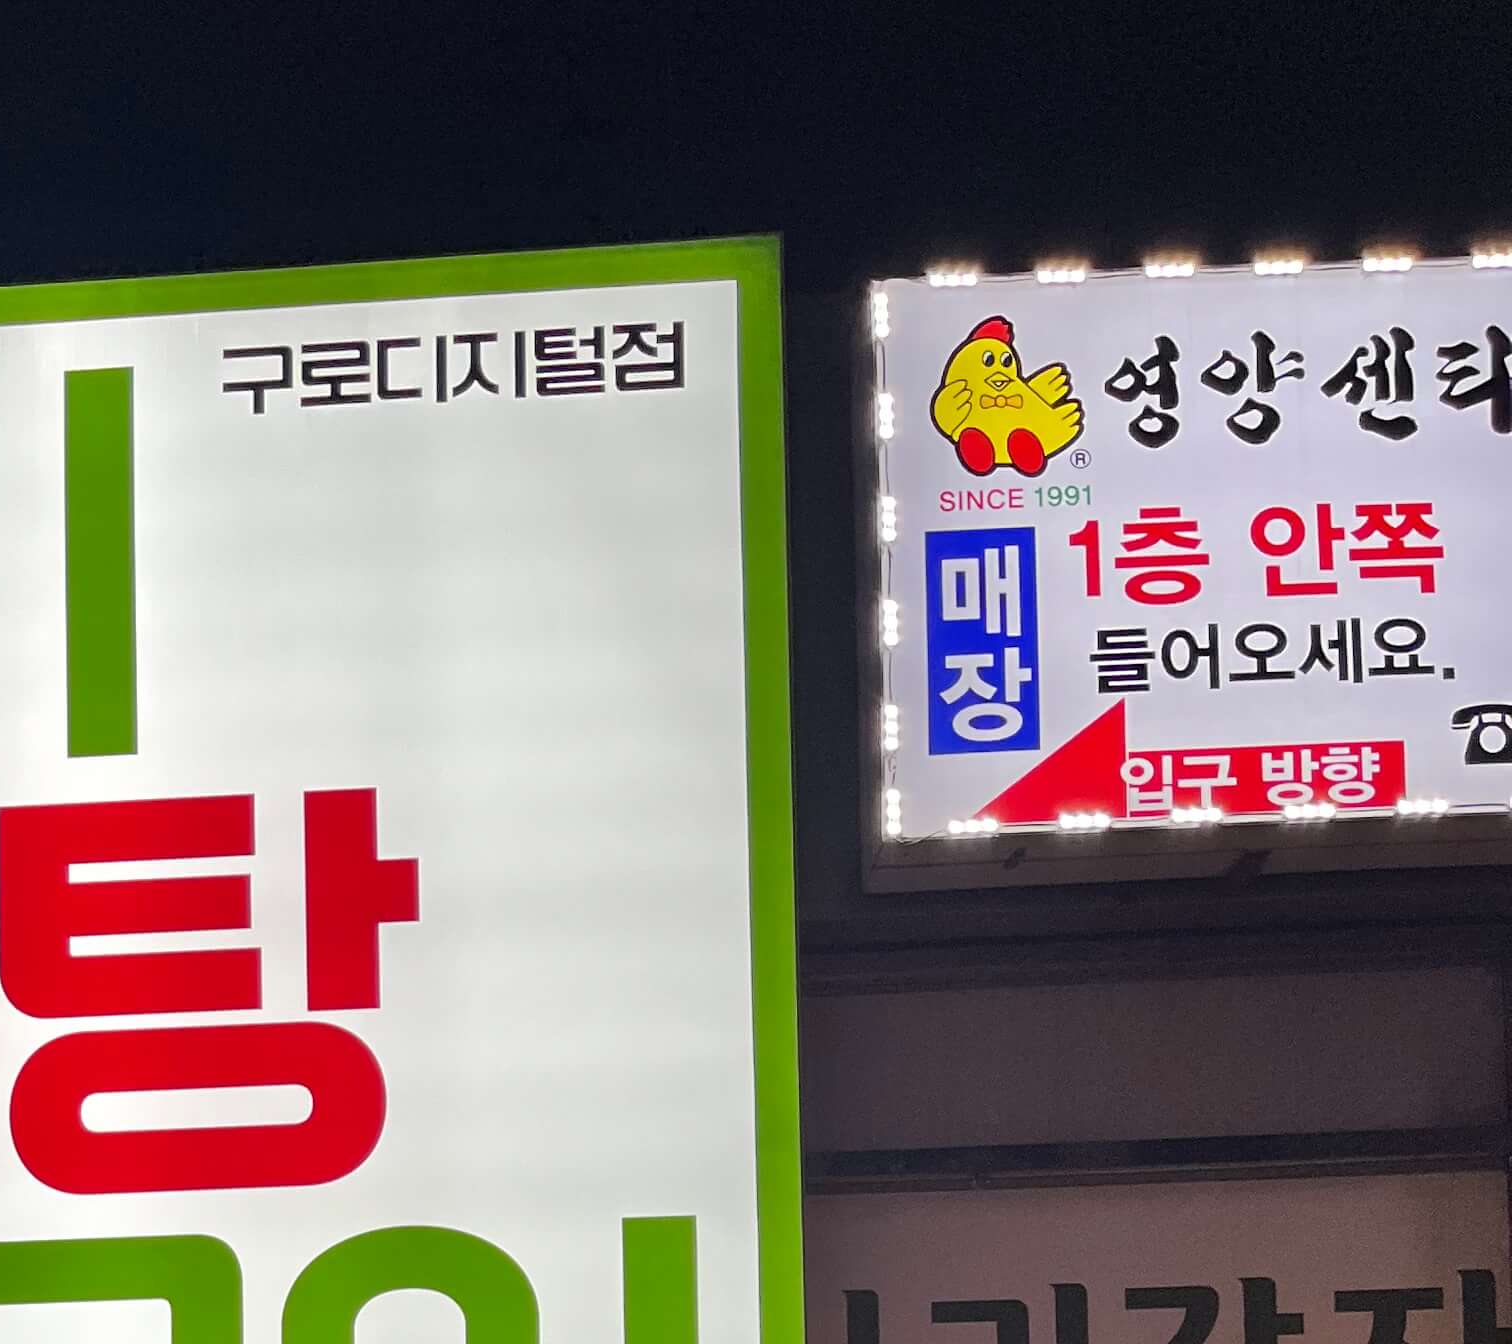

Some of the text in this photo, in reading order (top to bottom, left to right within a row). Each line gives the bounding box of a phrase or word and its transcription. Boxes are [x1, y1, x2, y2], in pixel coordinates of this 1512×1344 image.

[221, 320, 686, 415] 구로디지털점
[939, 485, 1092, 512] SINCE 1991
[1069, 502, 1445, 605] 1층 안쪽
[939, 544, 1031, 742] 매장
[1090, 617, 1455, 694] 들어오세요.
[1120, 746, 1381, 817] 입구 방향
